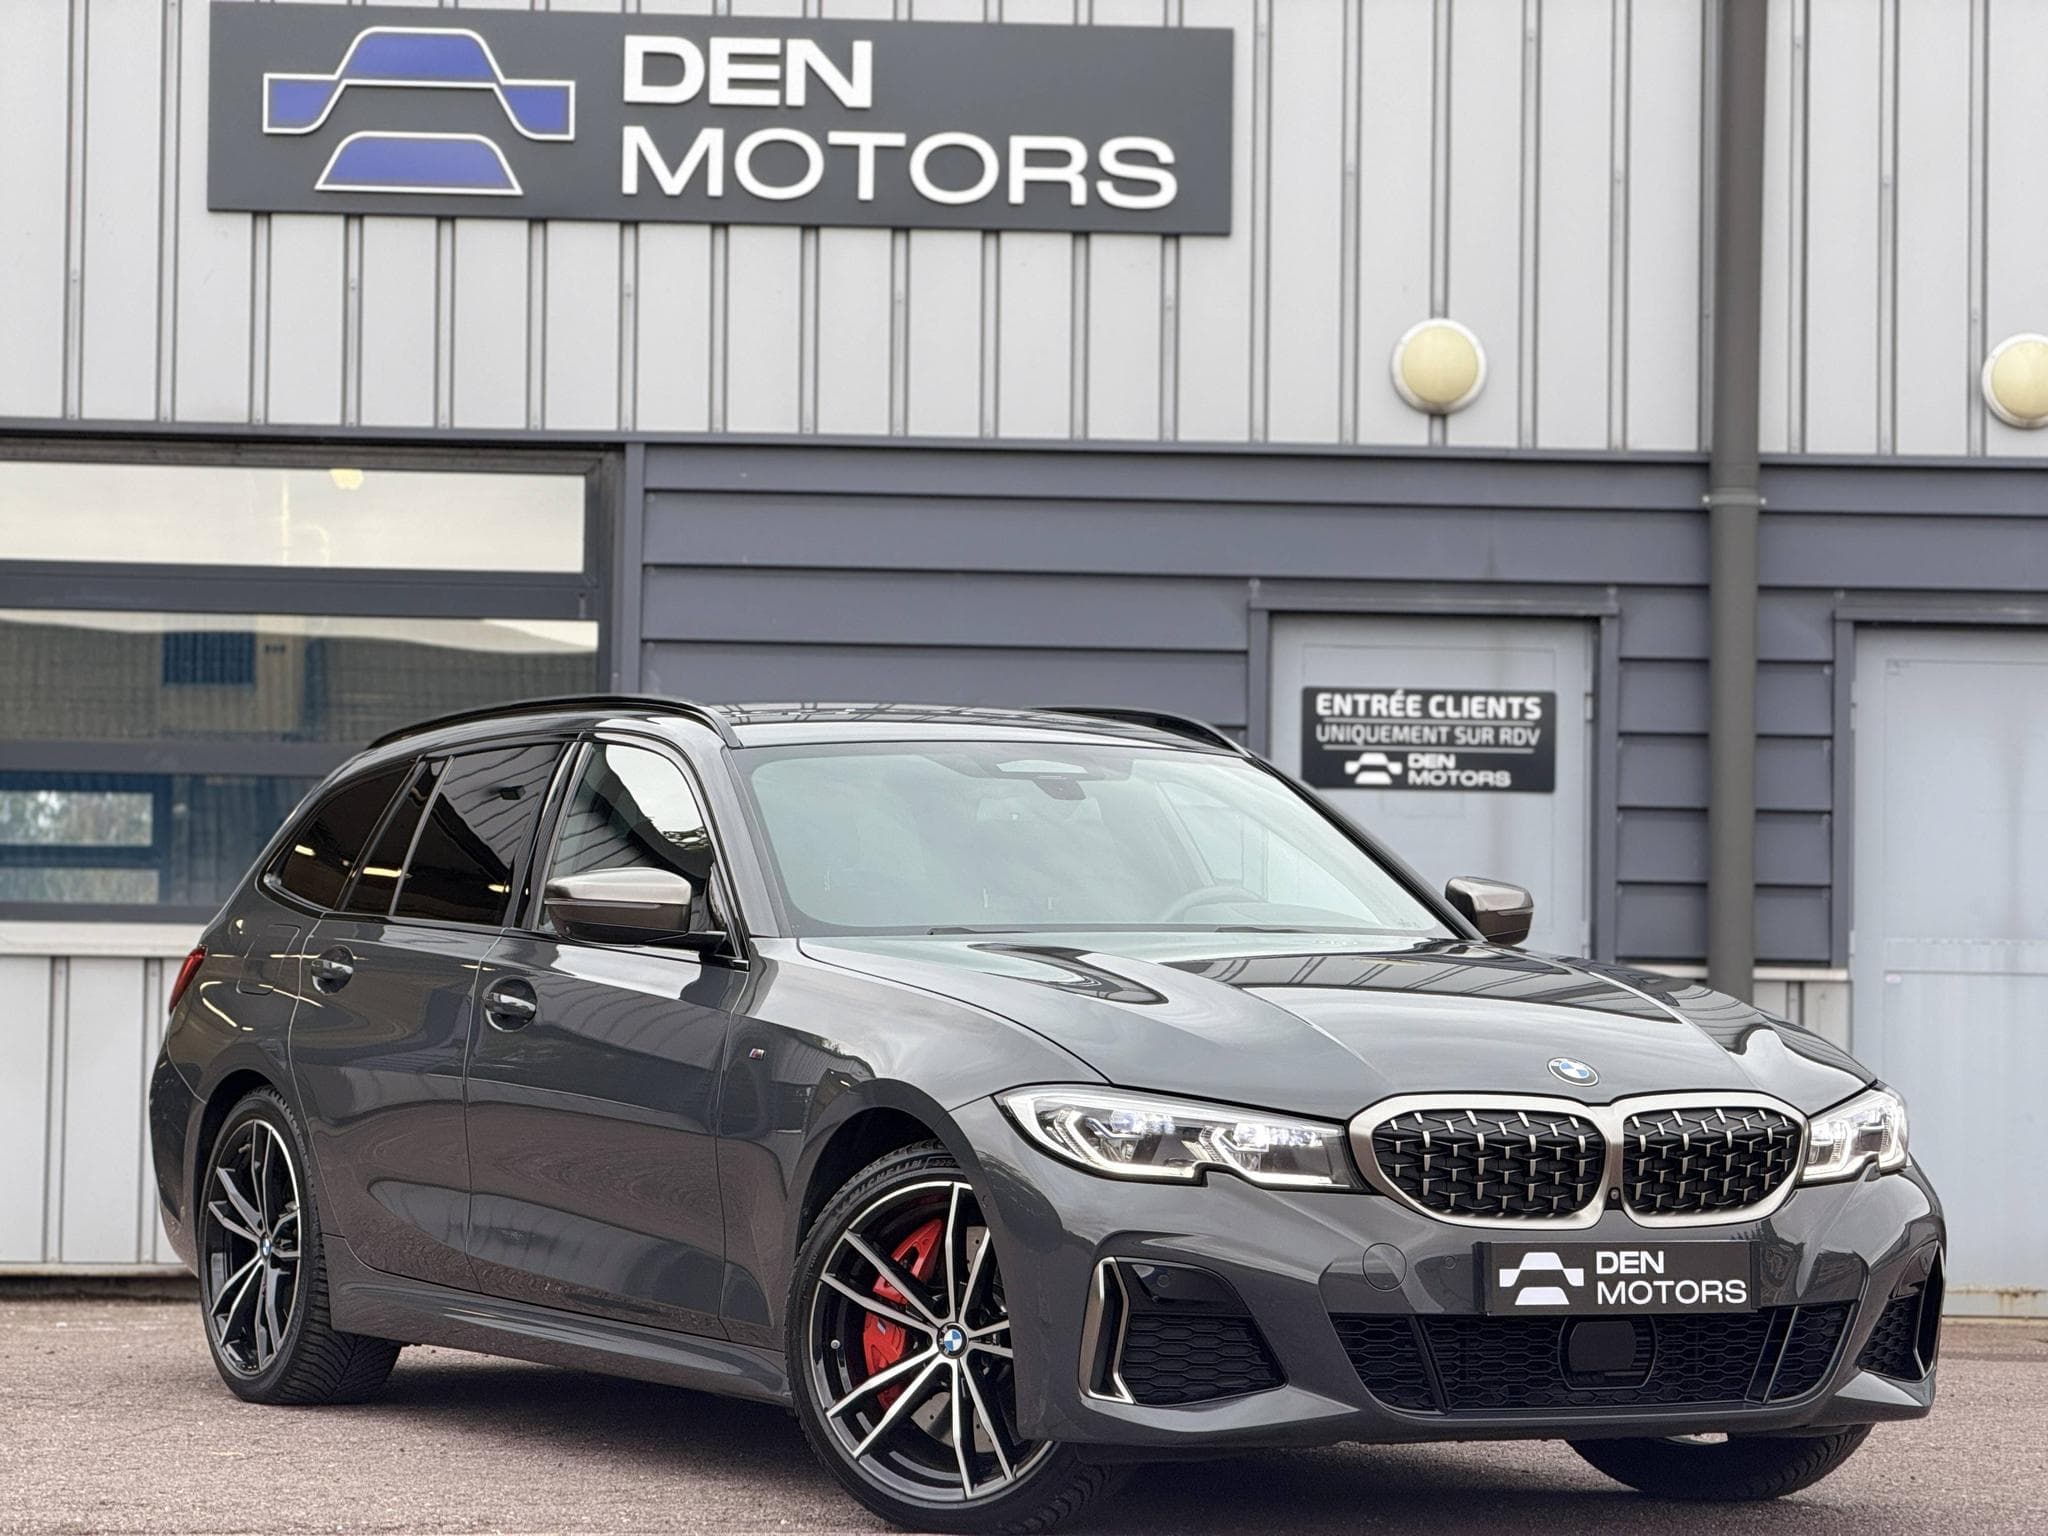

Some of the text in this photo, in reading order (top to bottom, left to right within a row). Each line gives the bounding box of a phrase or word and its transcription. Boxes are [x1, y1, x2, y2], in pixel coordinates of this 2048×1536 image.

[623, 34, 873, 108] DEN
[622, 125, 1178, 209] MOTORS
[1315, 688, 1542, 720] ENTRÉE CLIENTS
[1315, 723, 1541, 747] UNIQUEMENT SUR RDV
[1407, 752, 1456, 770] DEN
[1407, 769, 1512, 788] MOTORS
[1596, 1250, 1665, 1275] DEN
[1597, 1279, 1747, 1305] MOTORS
